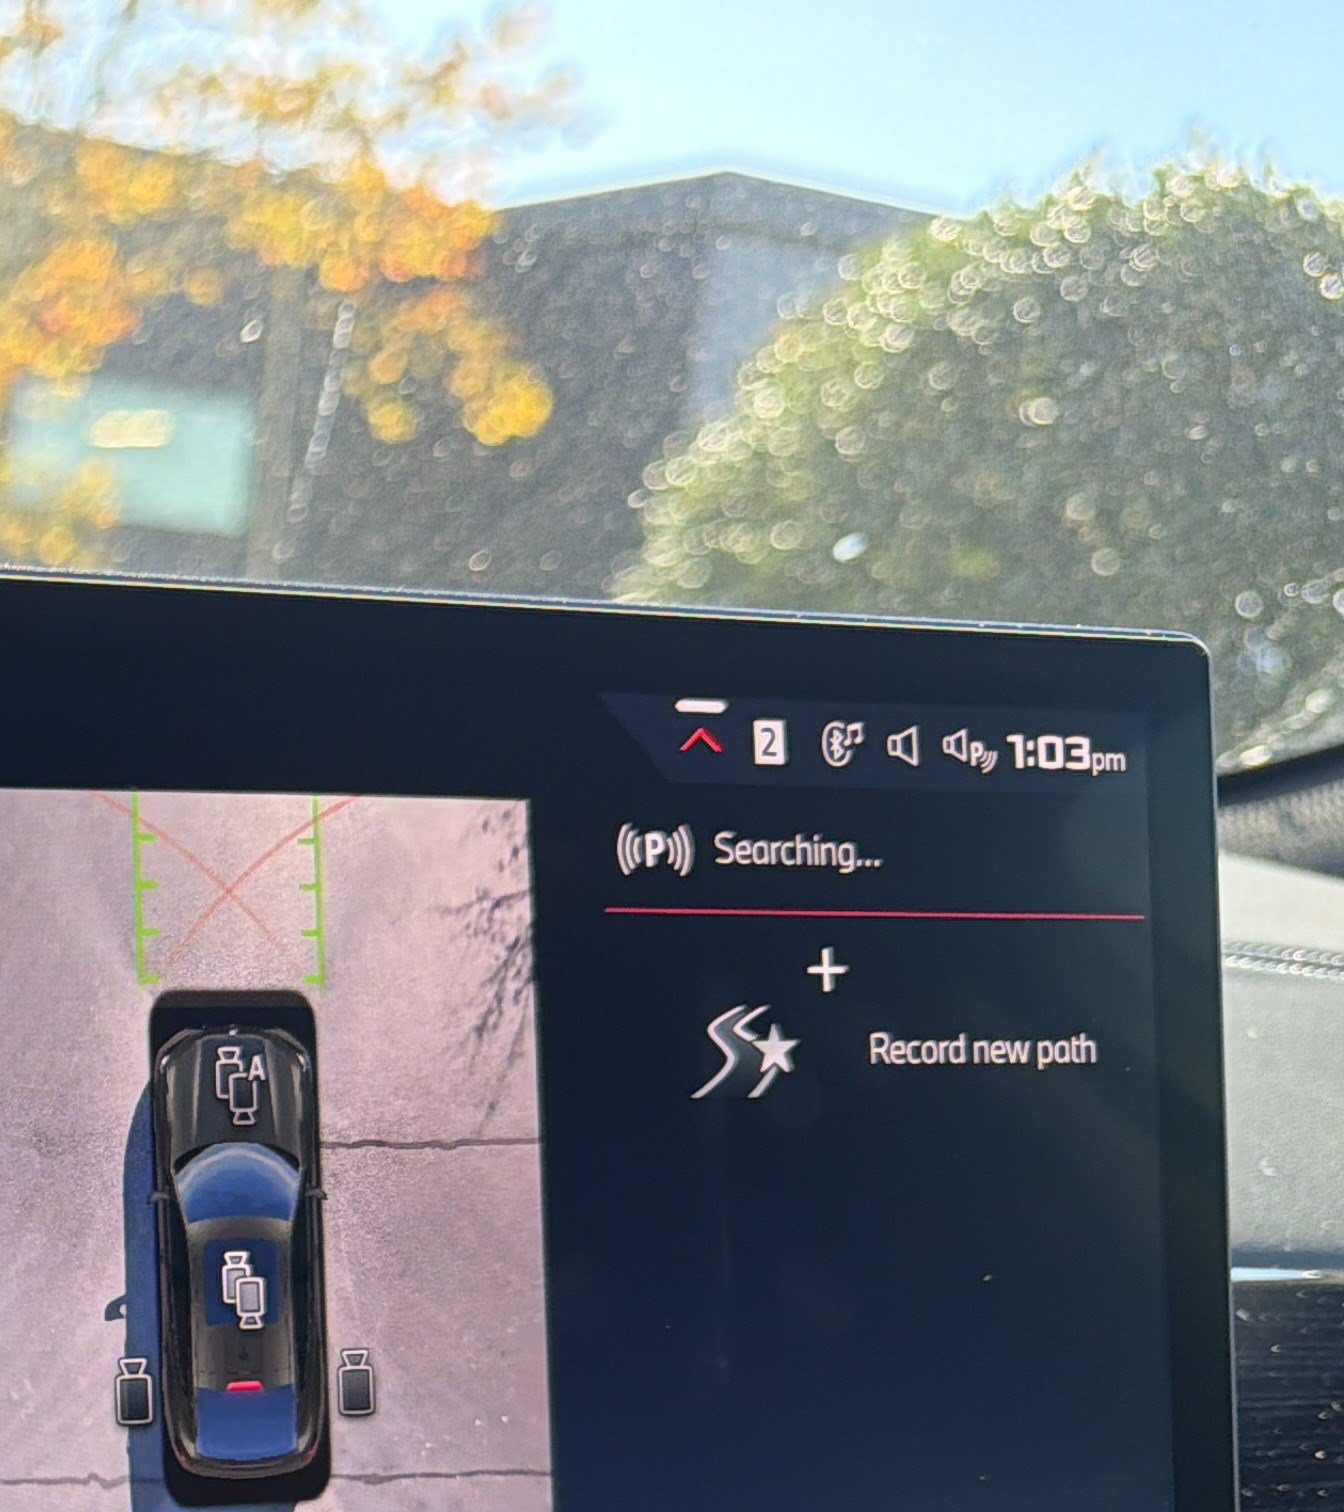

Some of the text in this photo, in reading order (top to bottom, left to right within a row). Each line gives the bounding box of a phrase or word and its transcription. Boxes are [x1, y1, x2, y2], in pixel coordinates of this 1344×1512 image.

[714, 831, 882, 875] Searching...
[869, 1031, 1098, 1070] Record new path
